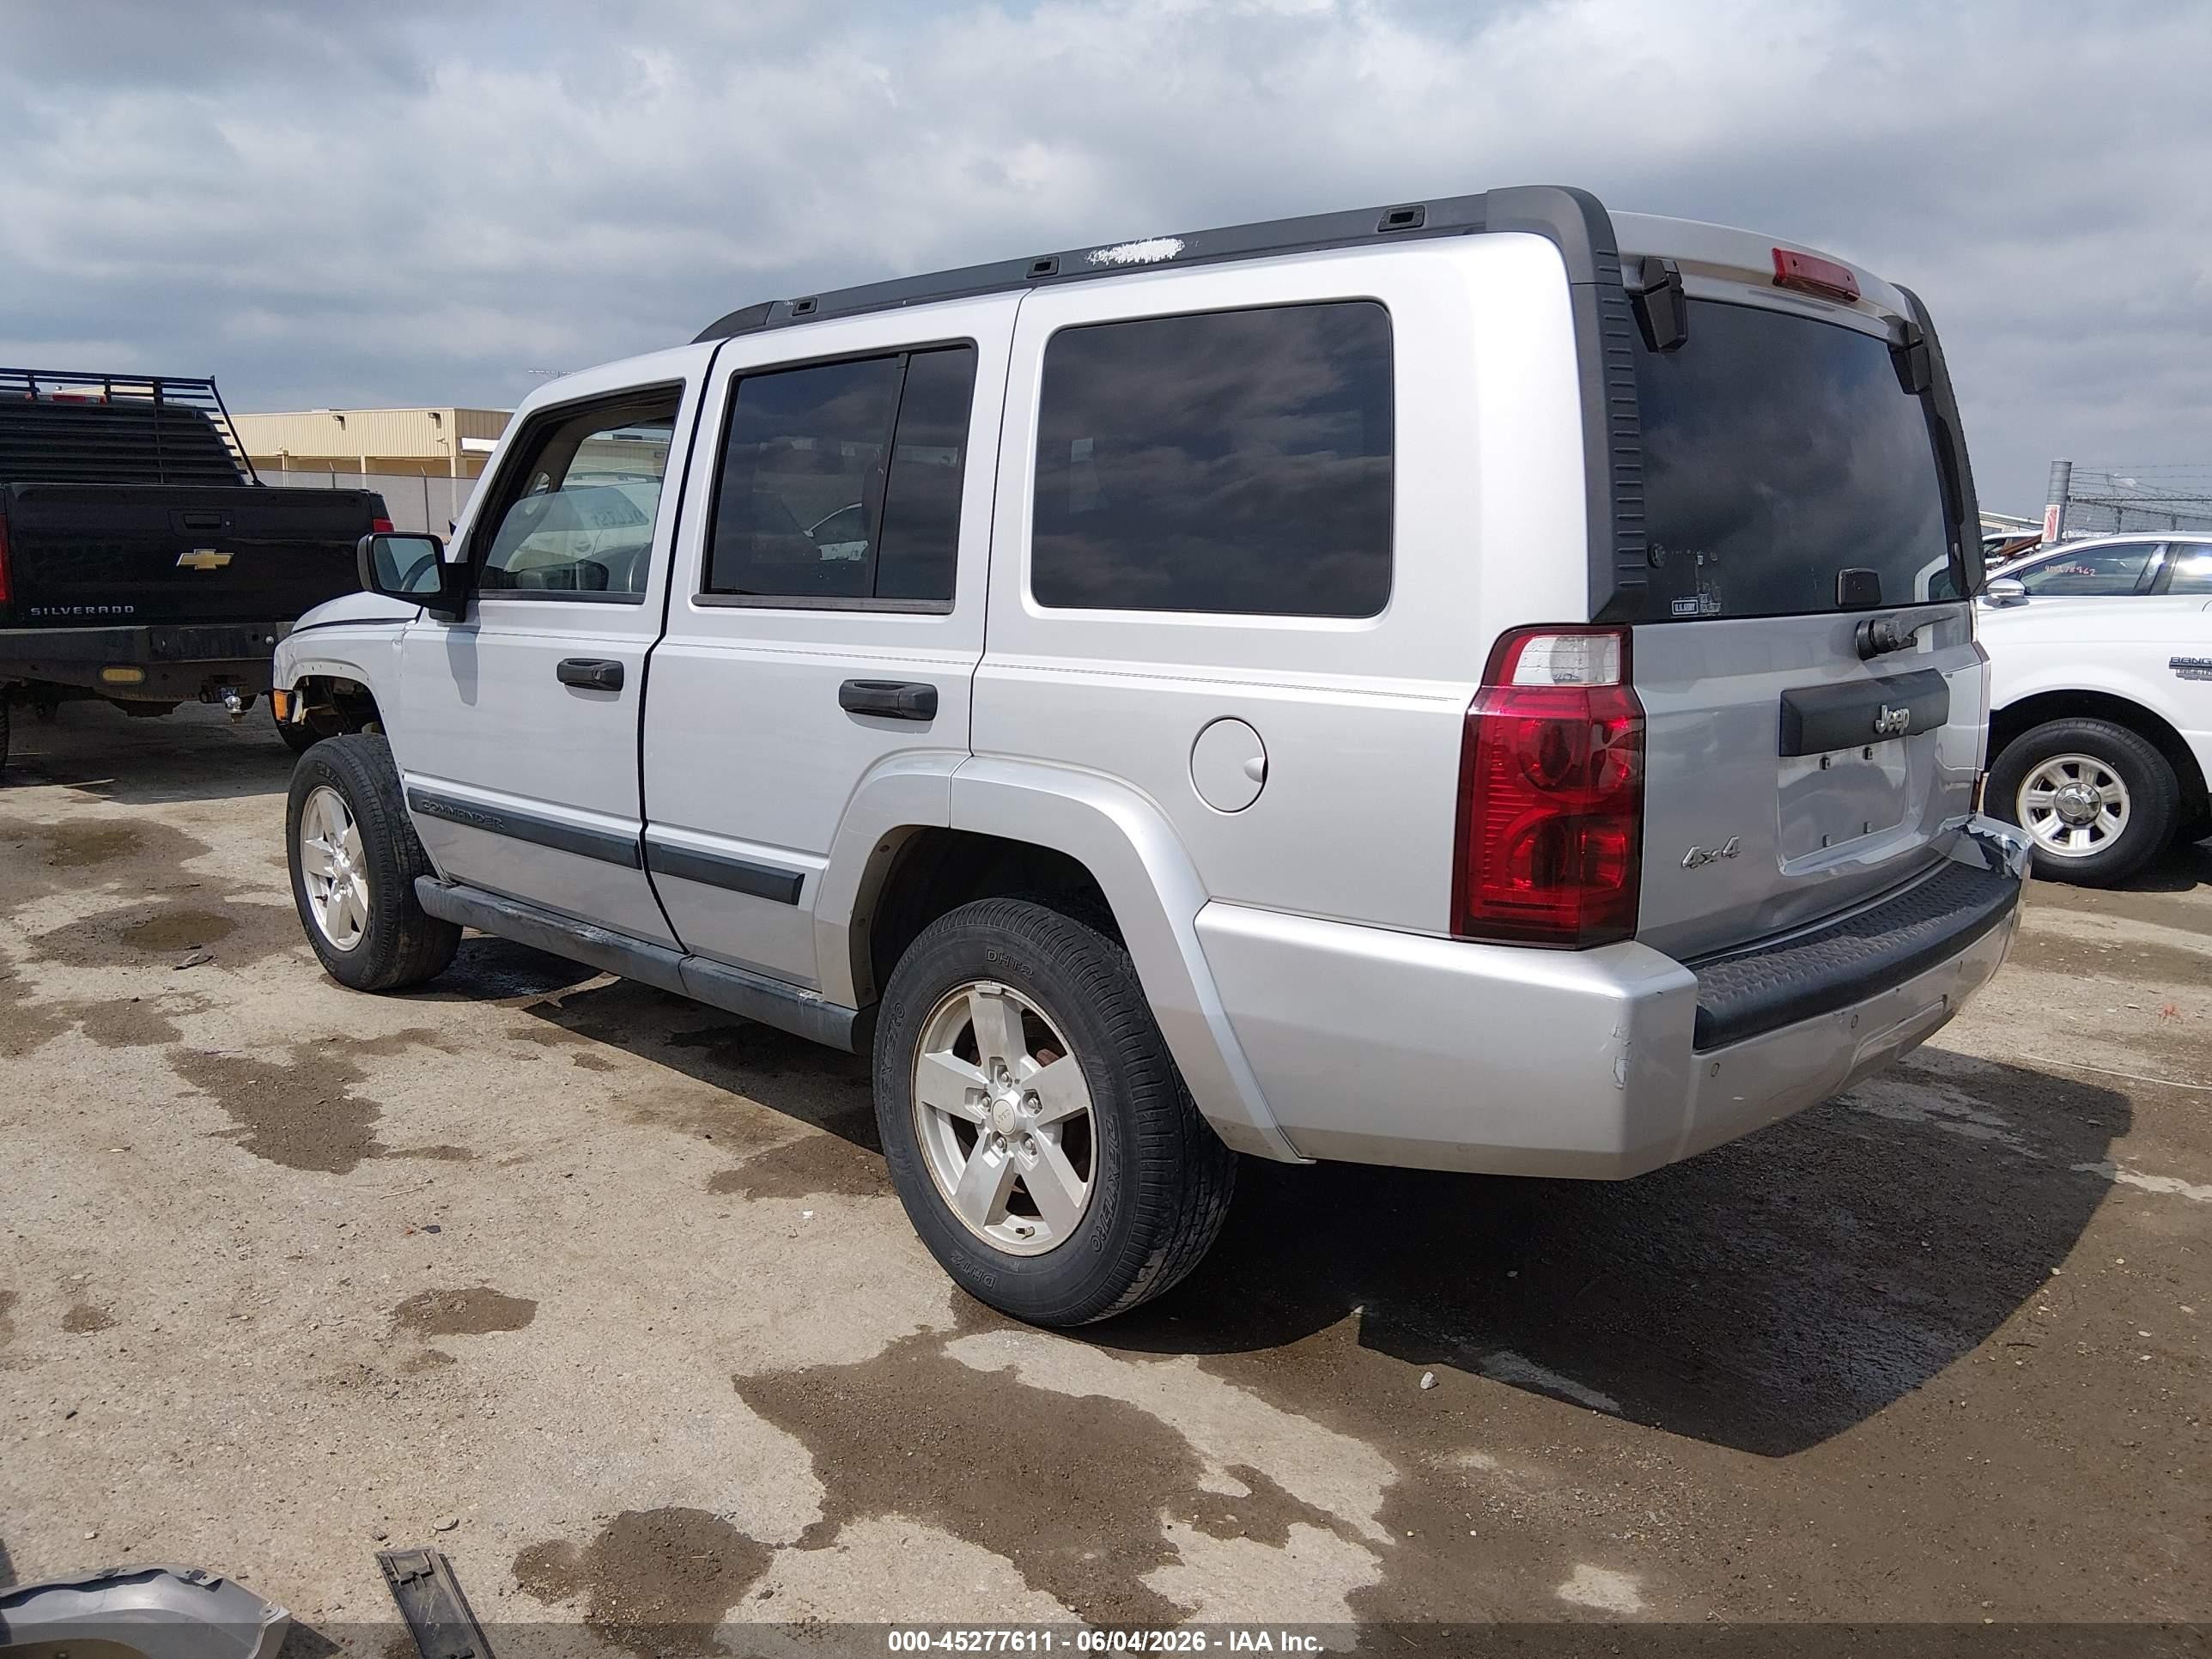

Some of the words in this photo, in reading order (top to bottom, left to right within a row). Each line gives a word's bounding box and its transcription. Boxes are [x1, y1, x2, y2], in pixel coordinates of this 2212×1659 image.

[30, 605, 135, 616] SILVERADO
[1875, 704, 1910, 735] Jeep
[1682, 836, 1740, 869] 4x4
